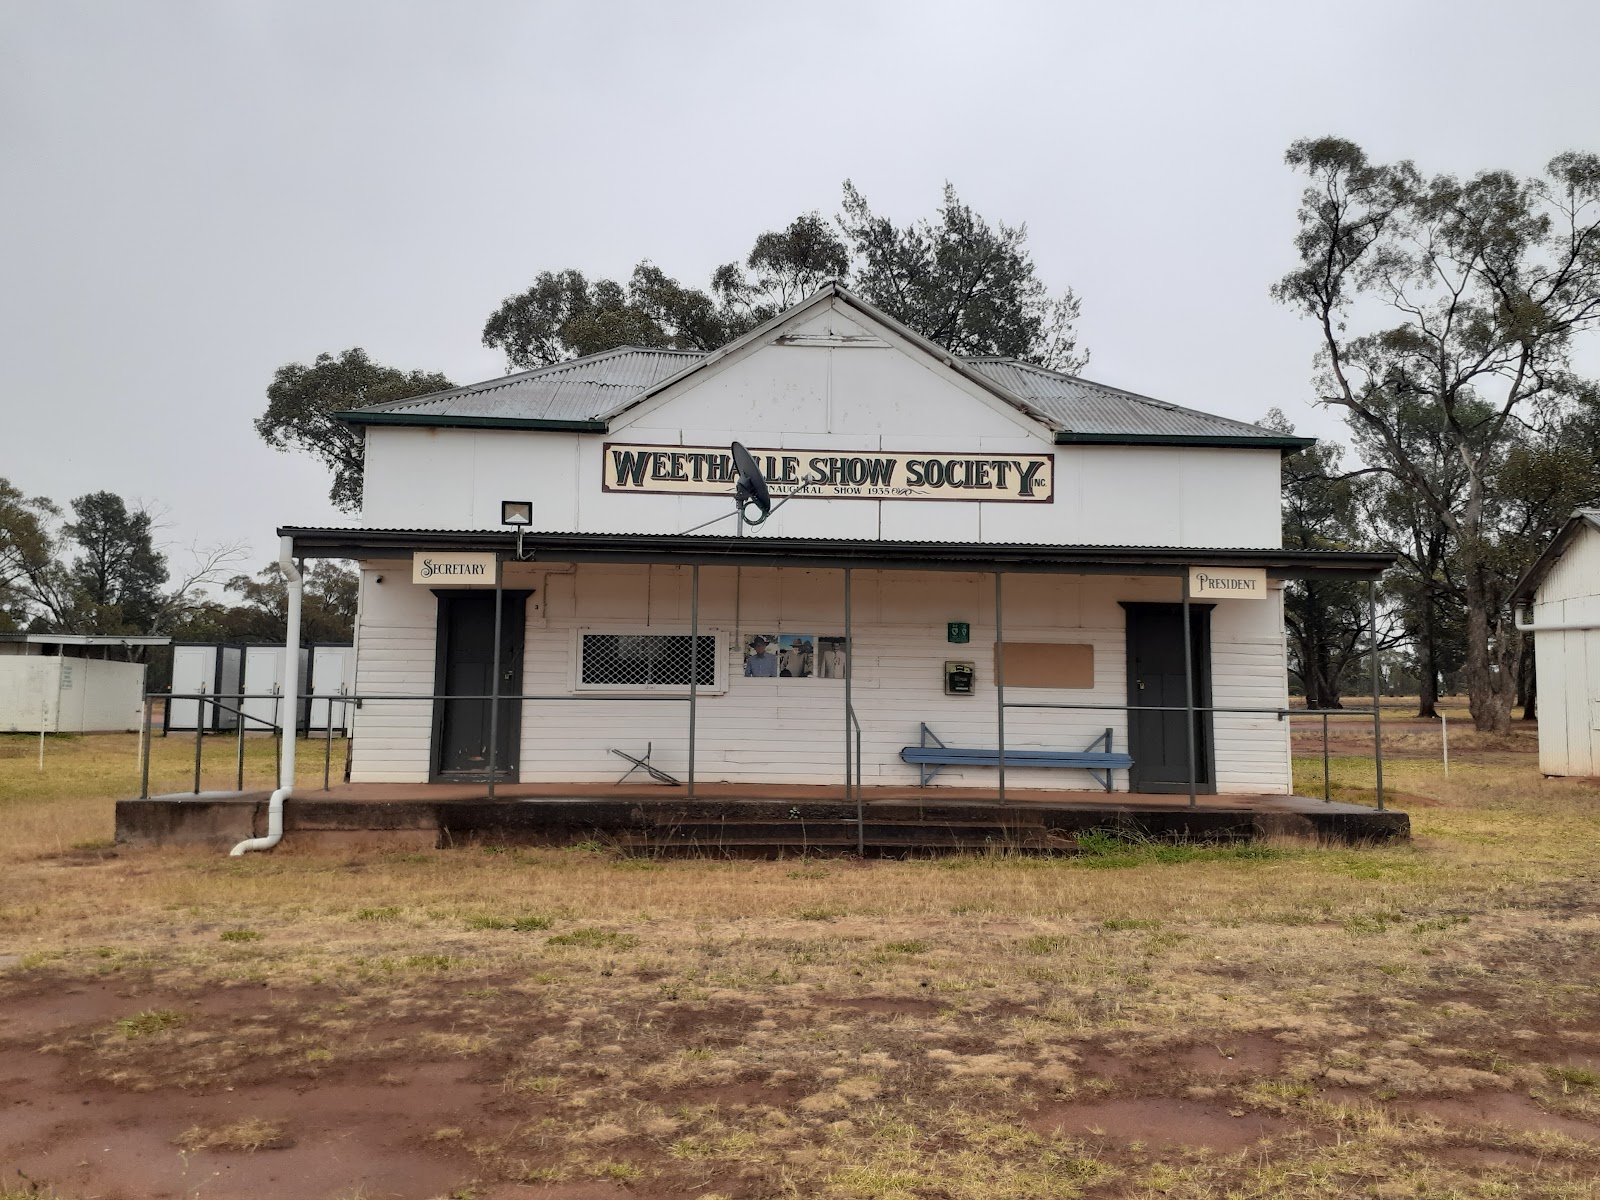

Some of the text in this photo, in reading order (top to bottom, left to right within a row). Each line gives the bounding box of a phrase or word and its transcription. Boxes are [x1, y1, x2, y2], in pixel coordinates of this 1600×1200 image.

[808, 457, 897, 487] SHOW
[906, 459, 1046, 497] SOCIETY
[768, 485, 891, 495] NAUGURAL SHOW 1935
[421, 559, 487, 578] SECRETARY
[1196, 573, 1256, 592] PRESIDENT
